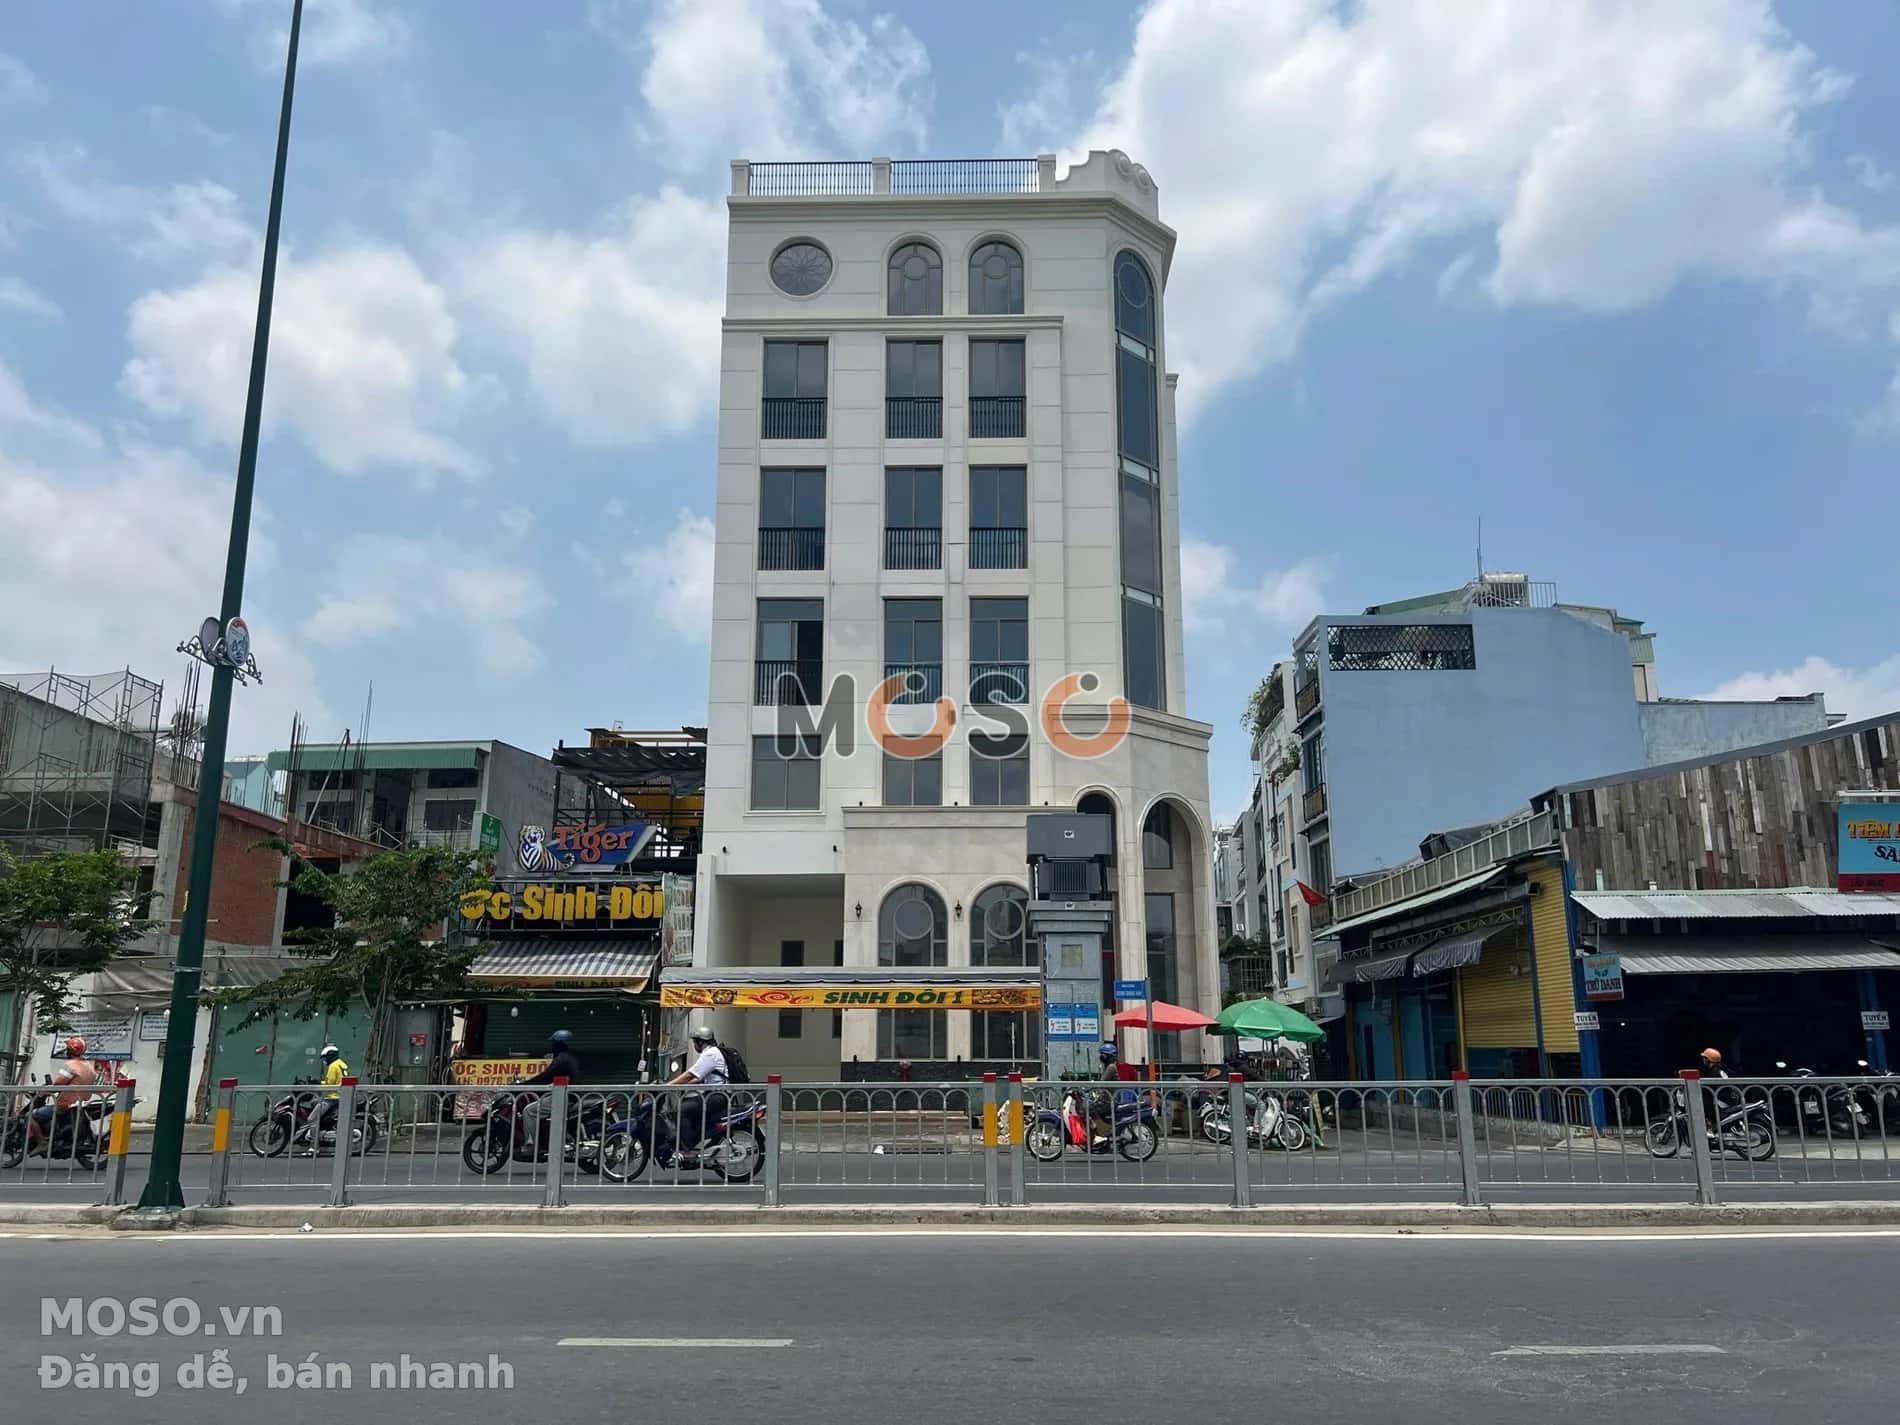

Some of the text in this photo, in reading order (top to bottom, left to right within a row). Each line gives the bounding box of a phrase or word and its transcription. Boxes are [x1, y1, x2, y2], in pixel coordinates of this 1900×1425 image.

[553, 822, 634, 863] Tiger
[522, 884, 597, 921] Sinh
[610, 883, 662, 920] Đôi
[824, 991, 890, 1004] SINH
[896, 989, 945, 1004] ĐÔI
[482, 1063, 522, 1075] SINH
